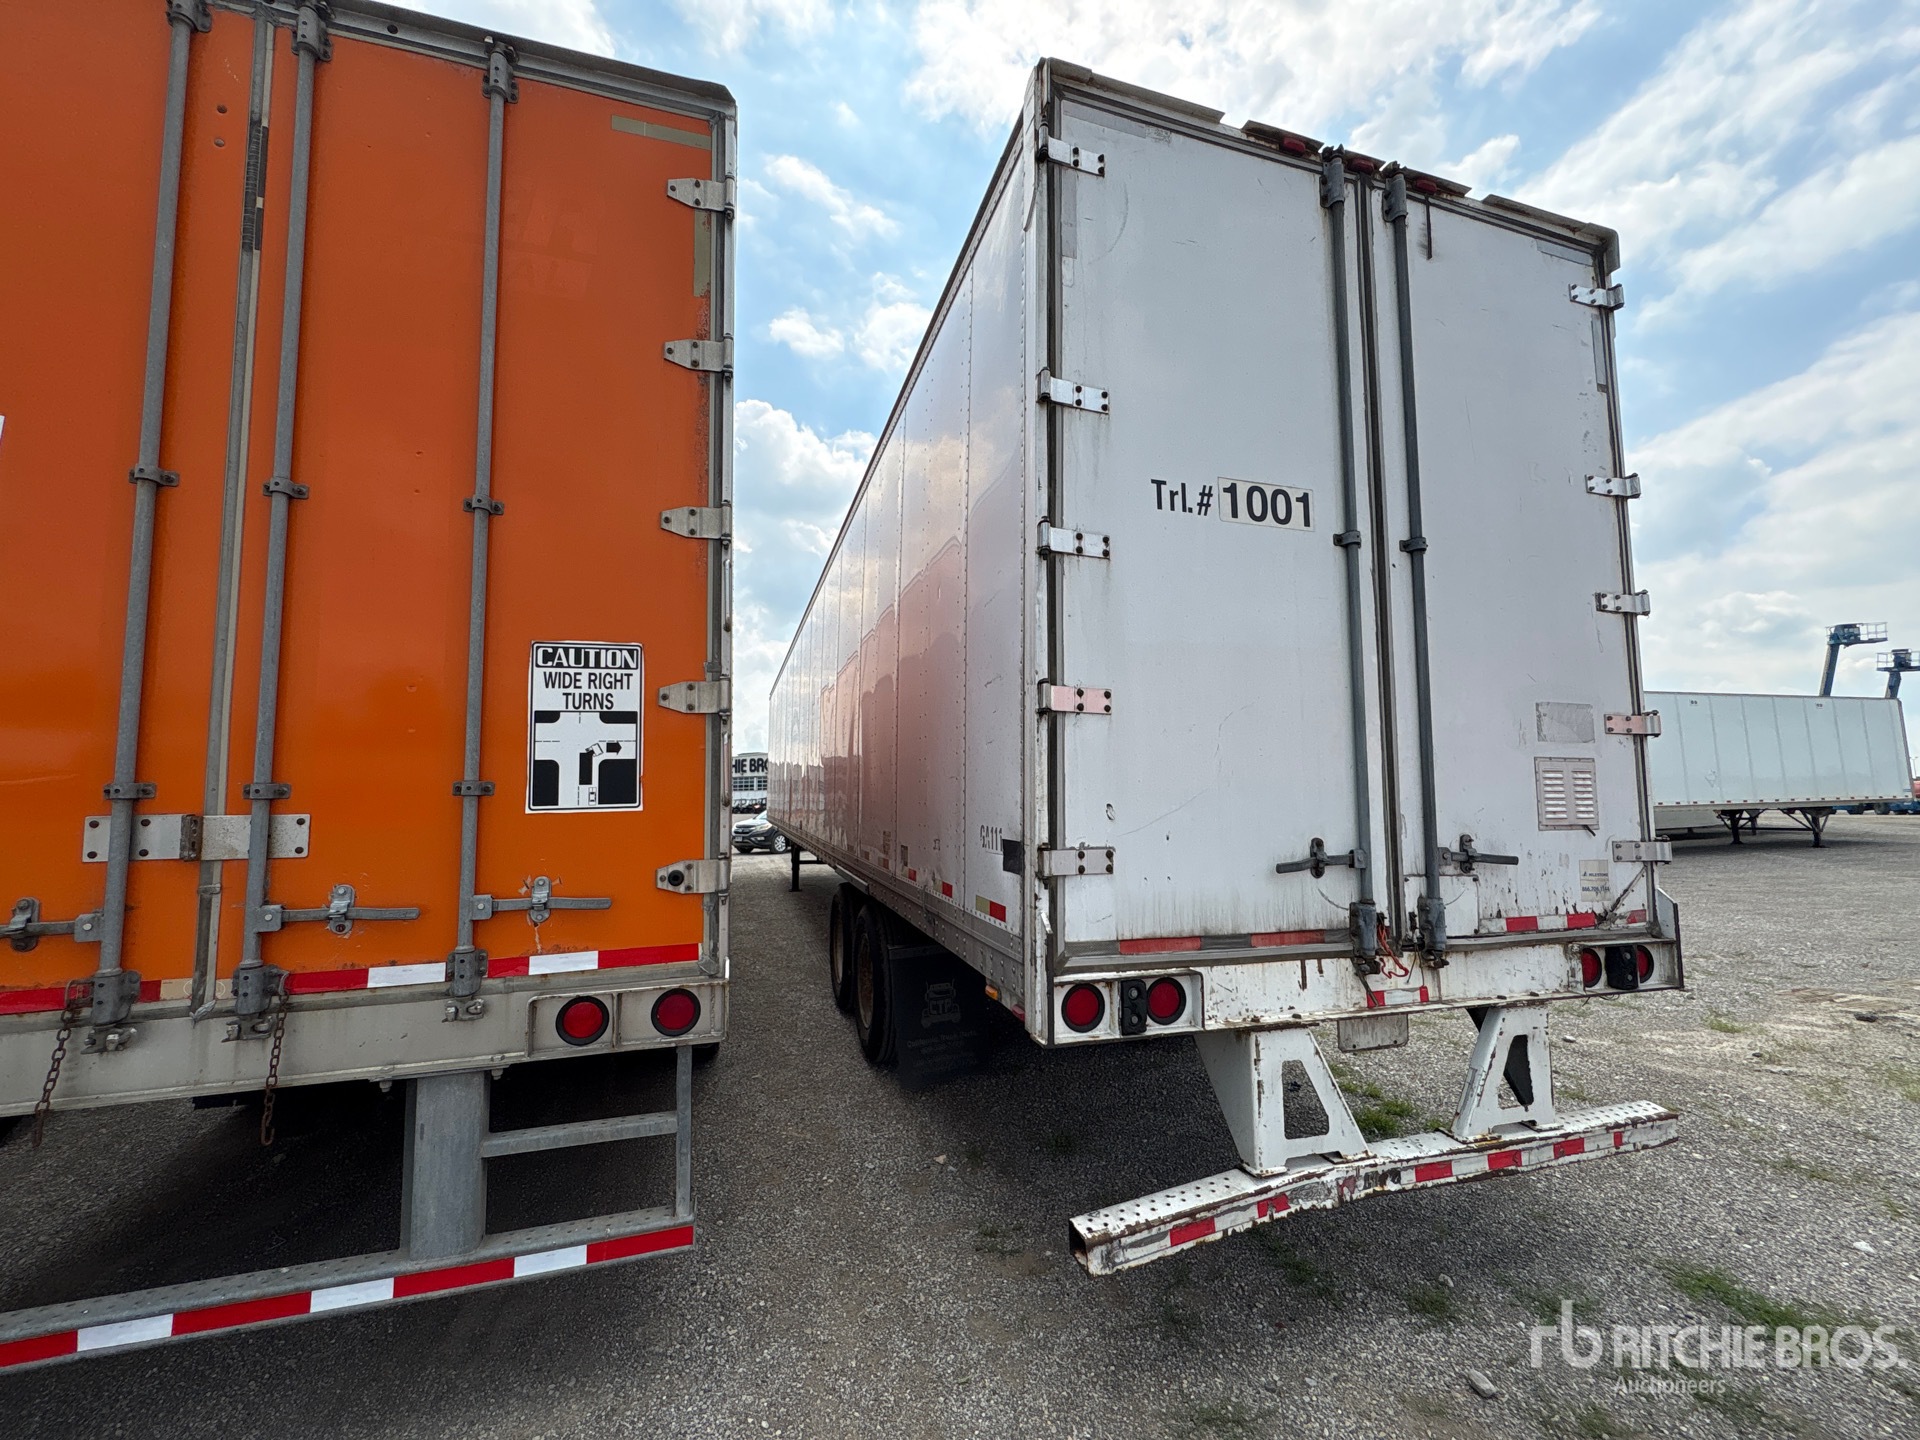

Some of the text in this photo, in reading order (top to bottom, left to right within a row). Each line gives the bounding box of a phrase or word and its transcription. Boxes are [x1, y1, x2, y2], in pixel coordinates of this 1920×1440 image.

[1222, 482, 1311, 528] 1001
[537, 647, 637, 668] CAUTION
[543, 671, 633, 690] WIDE RIGHT
[562, 692, 614, 710] TURNS
